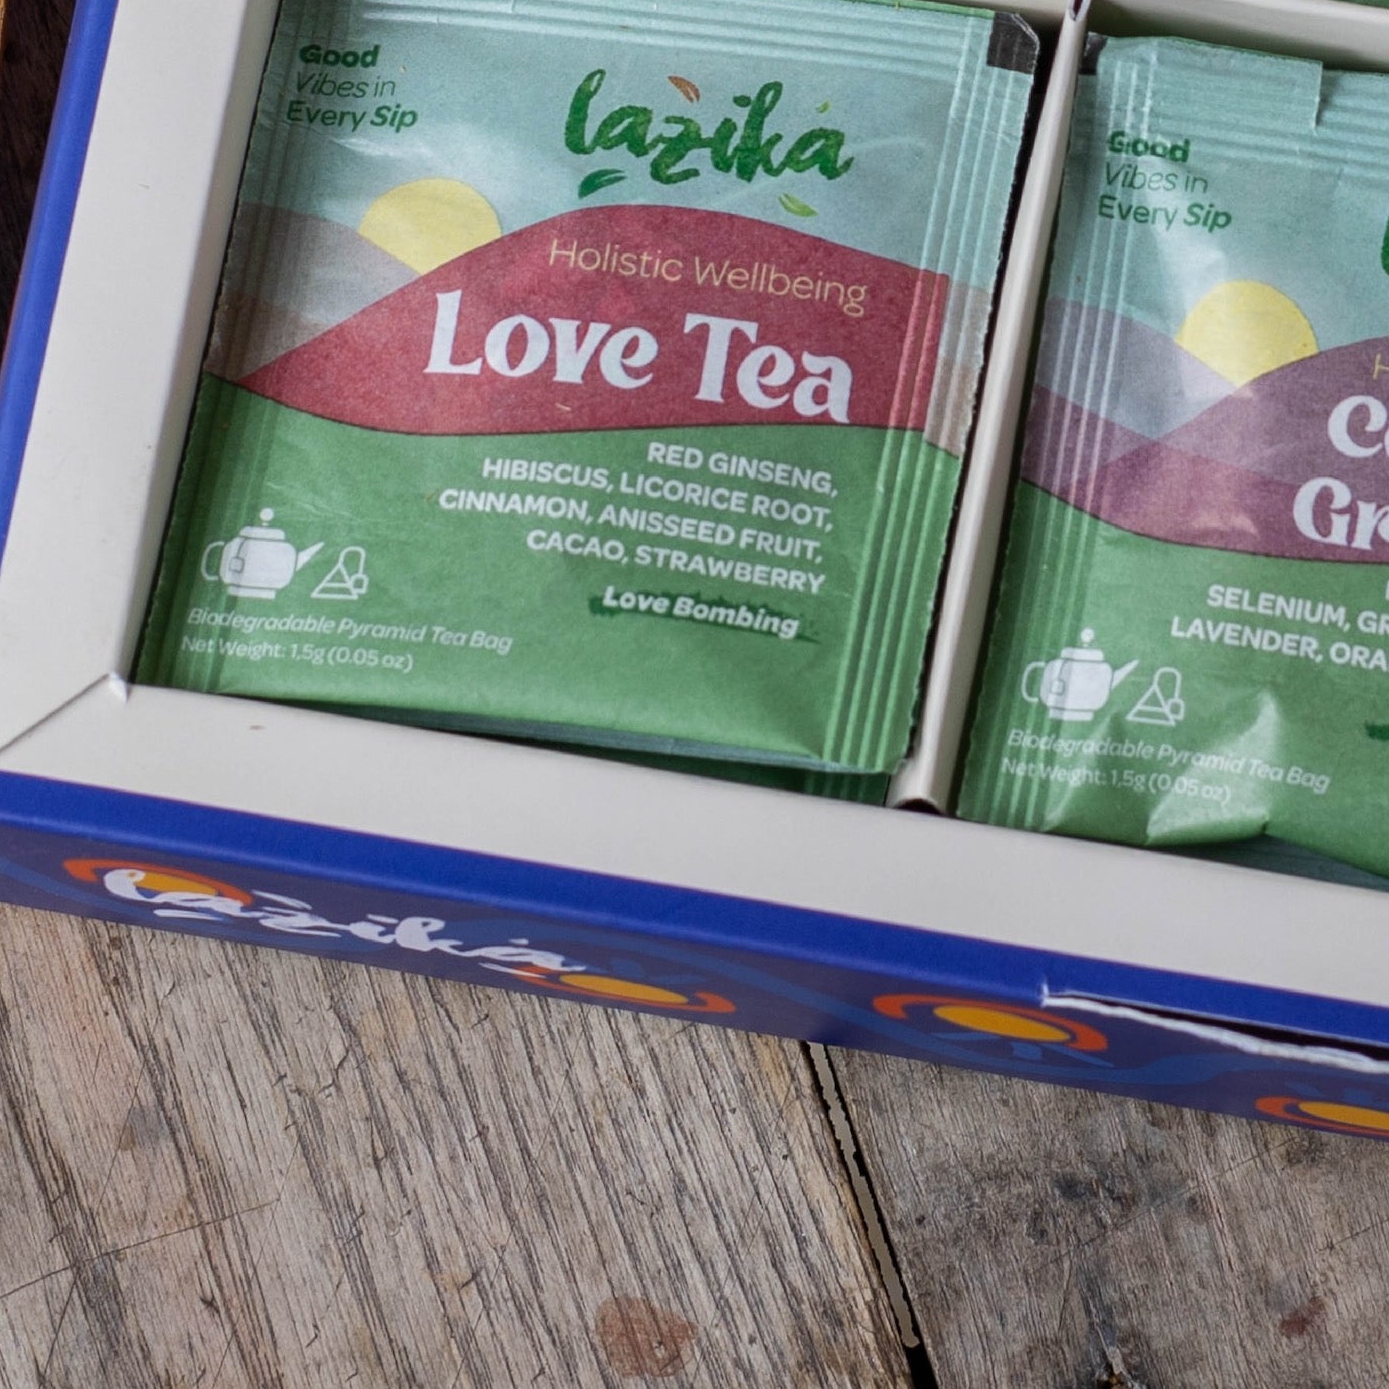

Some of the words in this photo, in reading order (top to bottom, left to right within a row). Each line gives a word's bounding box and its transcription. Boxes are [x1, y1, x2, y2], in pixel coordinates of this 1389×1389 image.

[423, 290, 658, 389] Love
[684, 313, 852, 423] Tea
[603, 586, 669, 613] Love
[673, 597, 799, 639] Bombing
